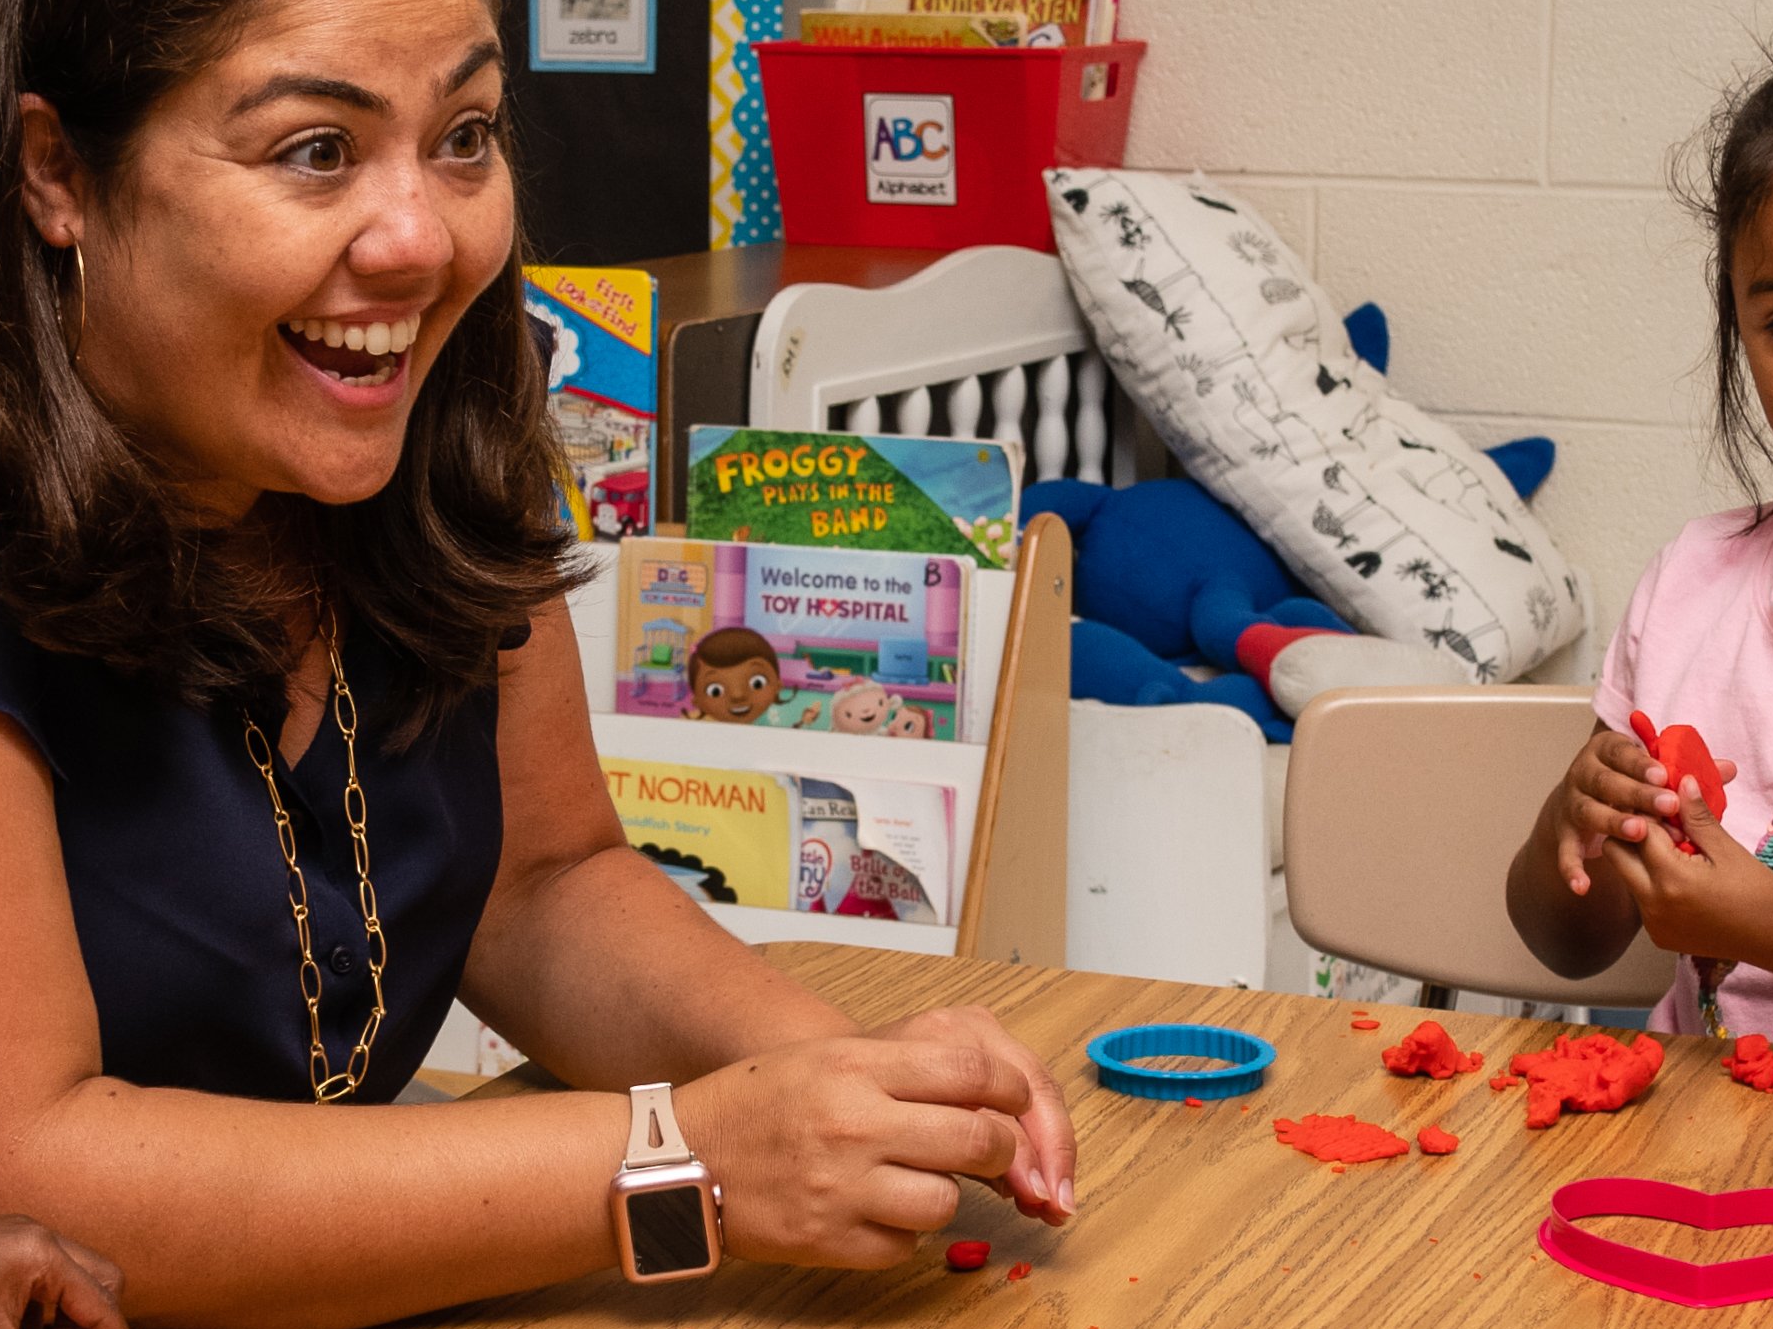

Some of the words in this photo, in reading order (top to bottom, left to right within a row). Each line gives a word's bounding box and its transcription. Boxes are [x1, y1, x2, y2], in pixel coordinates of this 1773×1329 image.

[569, 29, 619, 47] zebra
[872, 116, 950, 163] ABC
[876, 179, 948, 198] Alphabet
[714, 444, 868, 494] FROGGY
[763, 482, 820, 507] PLAYS
[829, 484, 850, 501] IN
[854, 483, 895, 504] THE
[810, 506, 888, 539] BAND
[760, 565, 857, 589] Welcome
[863, 575, 880, 591] to
[885, 577, 913, 596] the
[761, 594, 801, 614] TOY
[638, 774, 766, 814] NORMAN
